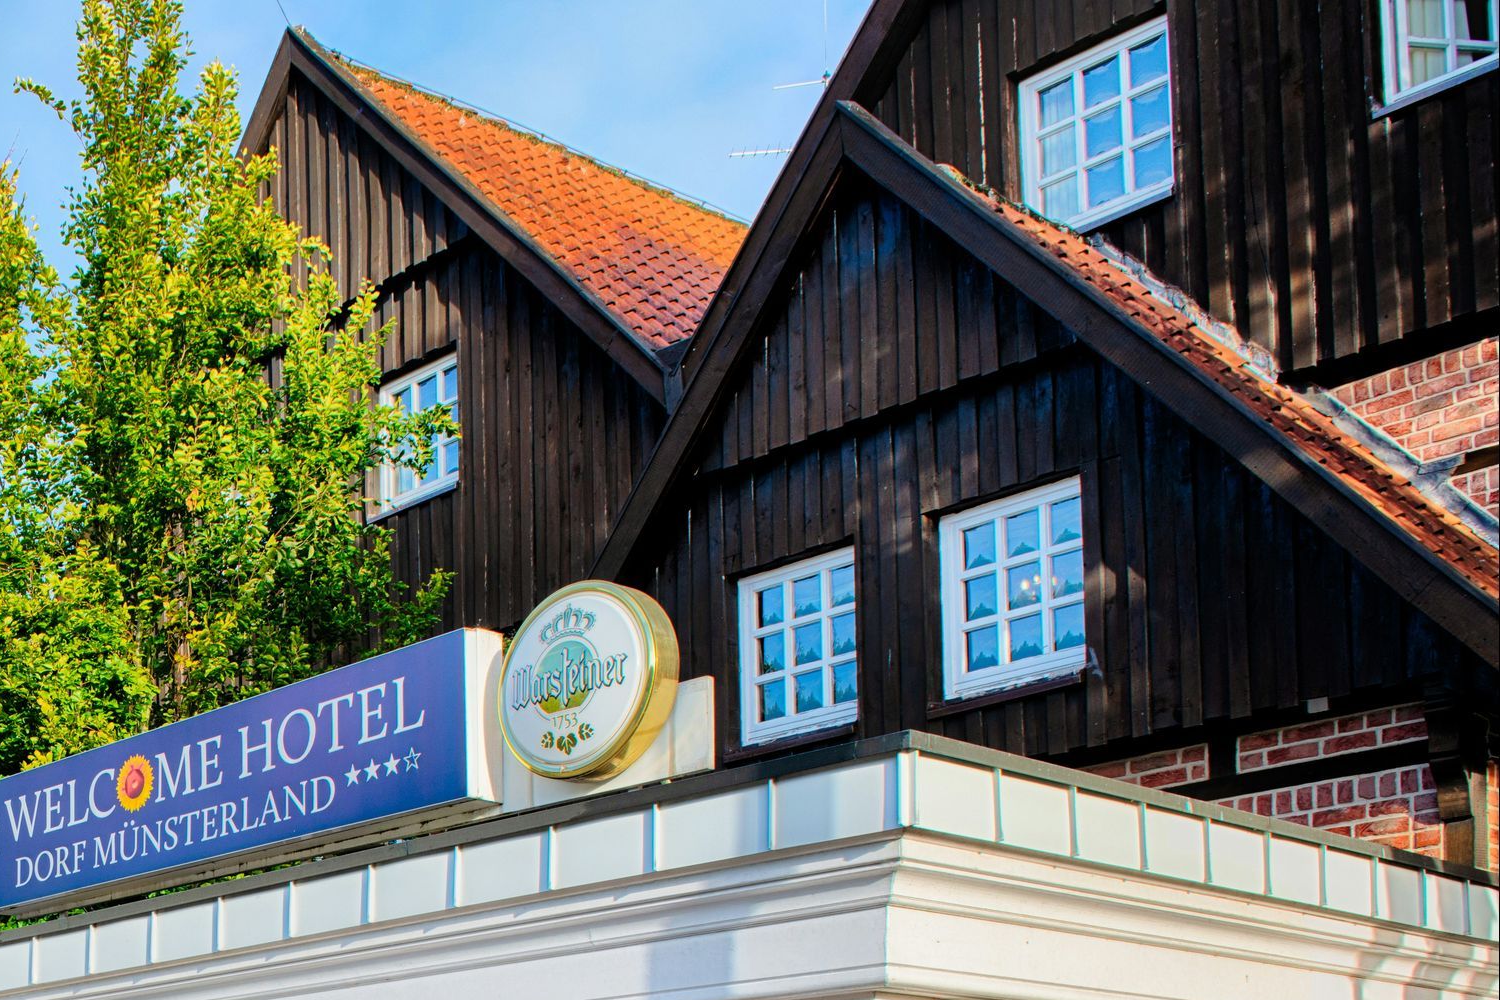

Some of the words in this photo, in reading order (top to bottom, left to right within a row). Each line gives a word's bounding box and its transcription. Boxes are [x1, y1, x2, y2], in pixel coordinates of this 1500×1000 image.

[4, 735, 222, 842] WELCOME
[238, 676, 426, 780] HOTEL
[550, 712, 579, 730] 1753
[15, 840, 87, 888] DORF
[93, 775, 336, 869] MÜNSTERLAND
